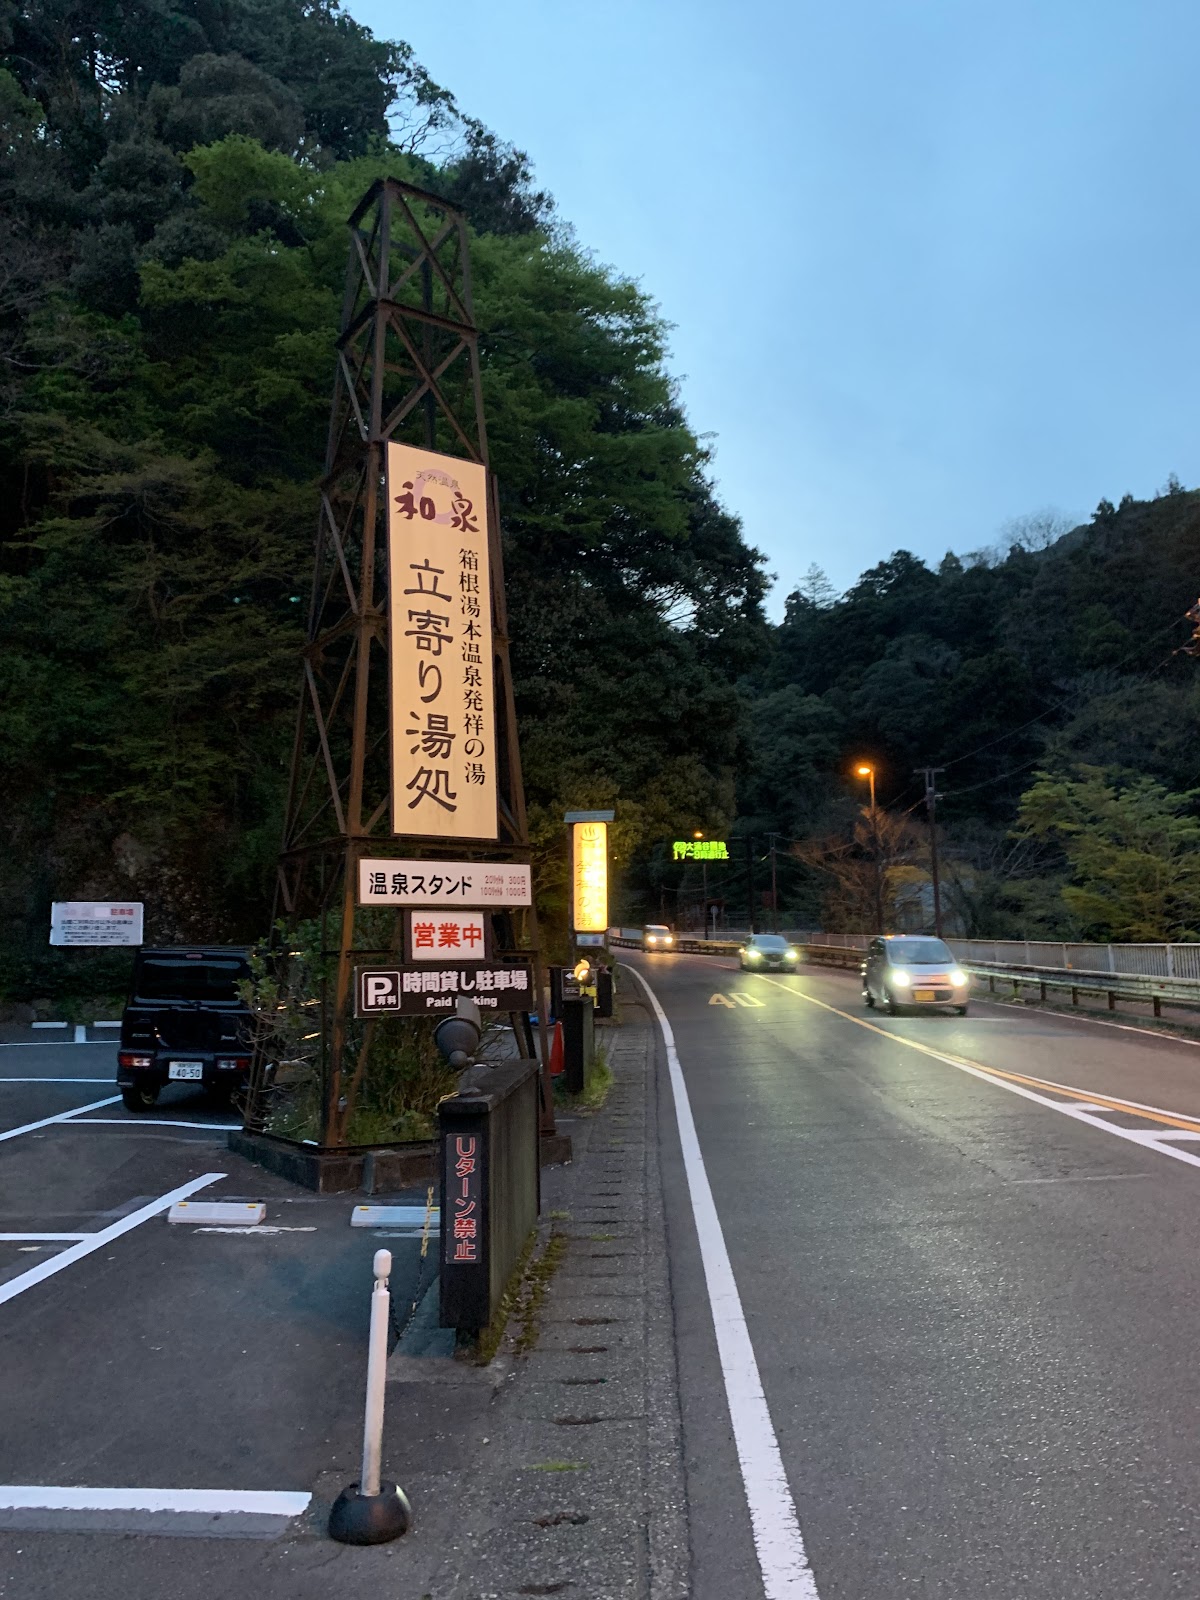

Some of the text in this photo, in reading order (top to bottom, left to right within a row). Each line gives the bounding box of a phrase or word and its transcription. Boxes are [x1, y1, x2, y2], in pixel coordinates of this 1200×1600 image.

[416, 471, 460, 489] 天然温泉
[394, 481, 480, 532] 和泉
[458, 548, 485, 787] 箱根湯本温泉発祥の湯
[403, 558, 457, 813] 立寄り湯処
[369, 872, 472, 896] 温泉スタンド
[506, 887, 527, 897] 1000円
[509, 876, 526, 886] 300円
[413, 922, 482, 949] 営業中
[367, 977, 393, 1006] P
[403, 970, 528, 993] 時間貸し駐車場
[376, 995, 397, 1006] 有料
[426, 995, 498, 1008] Paid king
[708, 993, 767, 1009] 40
[176, 1068, 201, 1078] 40-50
[454, 1136, 477, 1260] Uターン禁止
